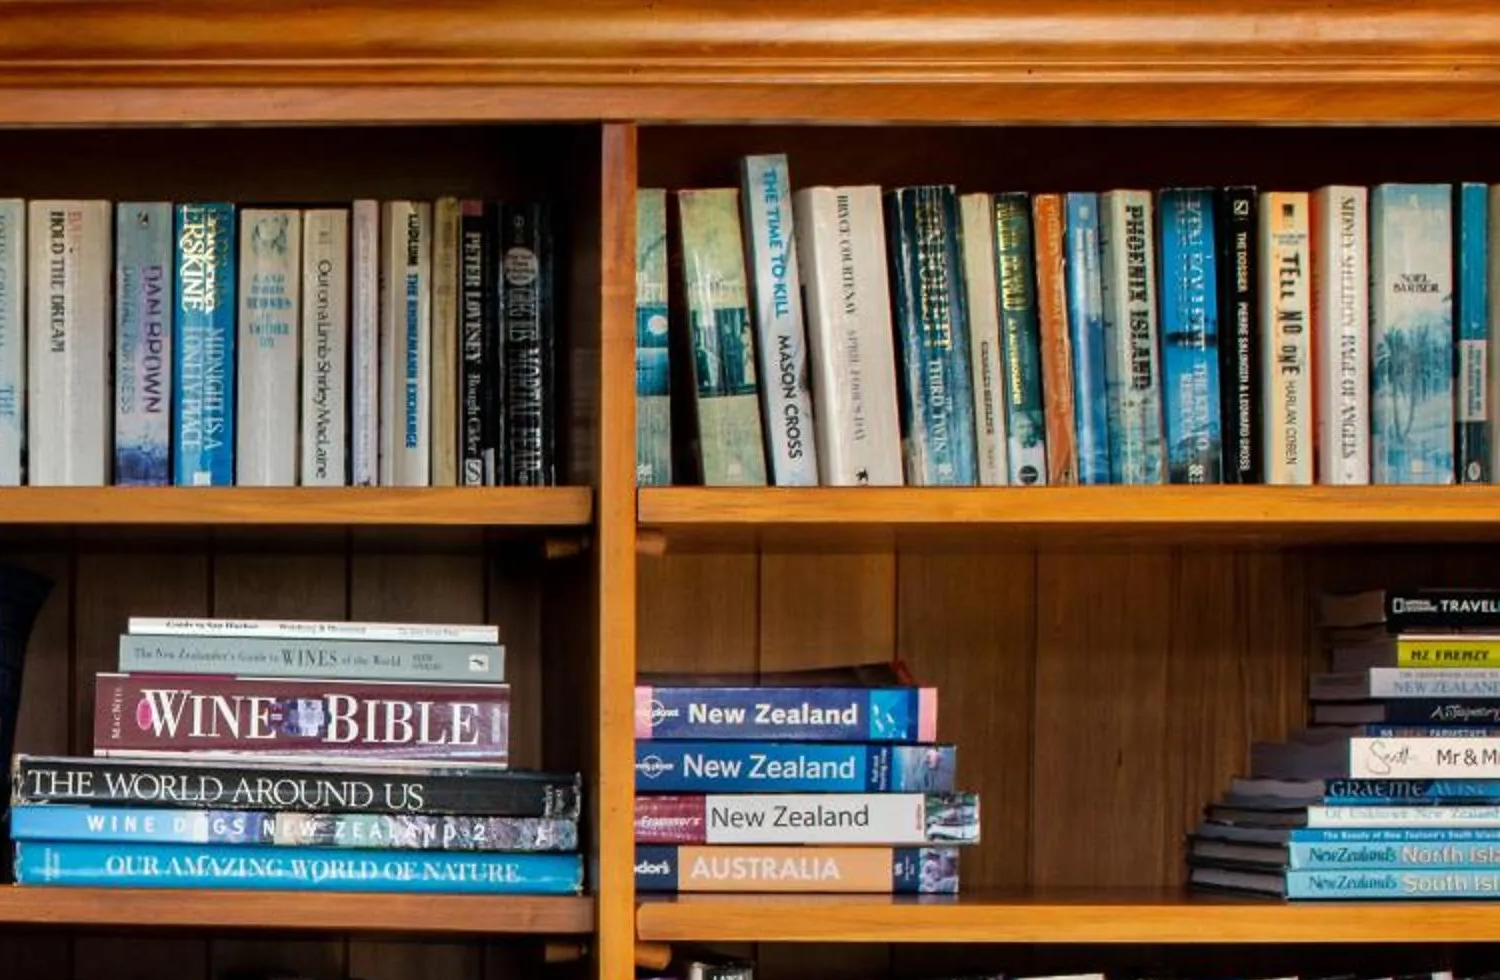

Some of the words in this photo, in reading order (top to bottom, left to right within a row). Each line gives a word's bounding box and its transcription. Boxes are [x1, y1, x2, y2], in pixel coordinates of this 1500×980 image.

[763, 169, 778, 204] THE
[50, 211, 64, 254] HOLD
[766, 208, 782, 248] TIME
[771, 255, 786, 277] TO
[1125, 204, 1148, 303] PHOENIX
[51, 259, 63, 290] THE
[143, 264, 162, 314] DAN
[773, 283, 788, 319] KILL
[51, 294, 64, 352] DREAM
[143, 322, 161, 414] BROWN
[777, 335, 798, 399] MASON
[1129, 310, 1153, 391] ISLAND
[783, 403, 802, 460] CROSS
[1442, 600, 1500, 613] TRAVEL
[140, 688, 276, 739] WINE
[323, 693, 480, 745] BIBLE
[688, 703, 744, 724] New
[754, 703, 859, 726] Zealand
[682, 754, 740, 778] New
[748, 753, 856, 780] Zealand
[27, 769, 95, 797] THE
[103, 772, 223, 801] WORLD
[231, 777, 374, 807] AROUND
[385, 783, 423, 810] US
[86, 814, 155, 832] WINE
[335, 822, 457, 843] ZEALAND
[473, 825, 486, 841] 2
[710, 807, 765, 829] New
[772, 806, 870, 829] Zealand
[105, 855, 161, 876] OUR
[165, 856, 283, 878] AMAZING
[290, 859, 378, 882] WORLD
[384, 861, 417, 880] OF
[421, 862, 520, 883] NATURE
[690, 857, 840, 881] AUSTRALIA
[1401, 845, 1463, 864] North
[1402, 875, 1467, 893] South
